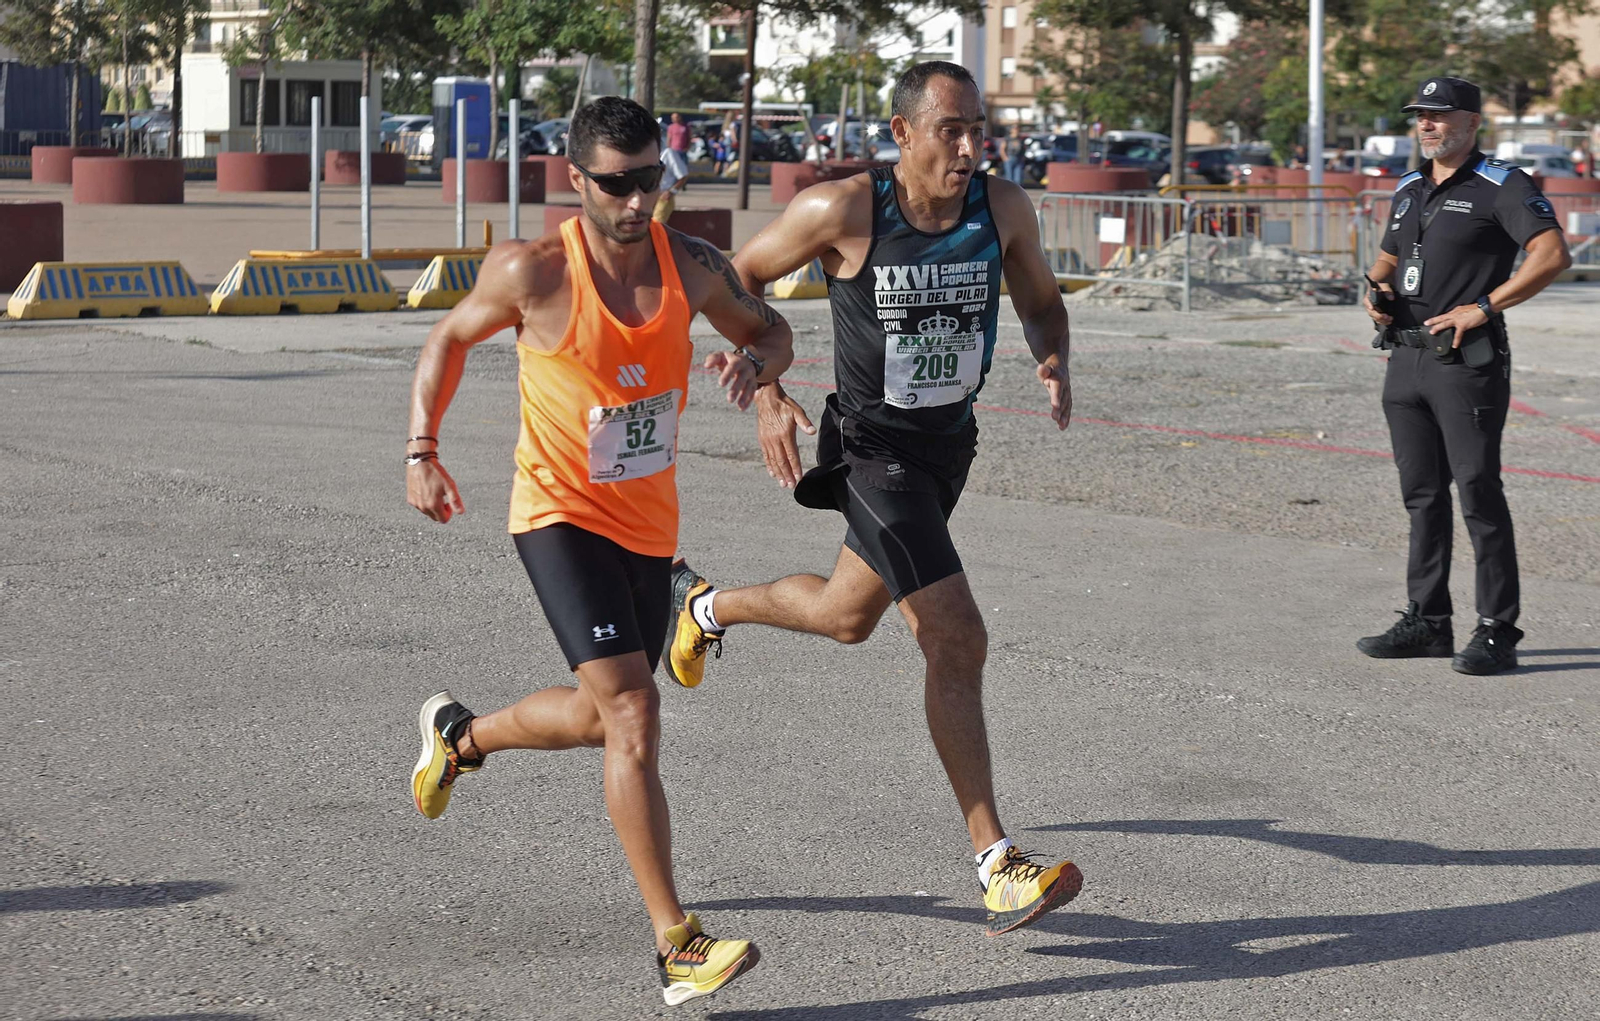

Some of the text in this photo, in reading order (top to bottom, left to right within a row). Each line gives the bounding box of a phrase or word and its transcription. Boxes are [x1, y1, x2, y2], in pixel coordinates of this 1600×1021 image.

[1444, 200, 1473, 208] POLICIA
[941, 261, 988, 275] CARRERA
[88, 275, 148, 292] APBA
[287, 271, 343, 287] APBA
[873, 264, 939, 291] XXVI
[941, 272, 987, 286] POPULAR
[878, 288, 986, 305] VIRGEN DEL PILAR
[877, 309, 907, 320] GUARDIA
[962, 303, 986, 313] 2024
[884, 321, 902, 332] CIVIL
[898, 335, 942, 346] XXVI
[898, 346, 928, 354] VIRGEN
[912, 352, 959, 381] 209
[907, 379, 962, 389] FRANCISCO ALMANSA
[626, 418, 656, 449] 52
